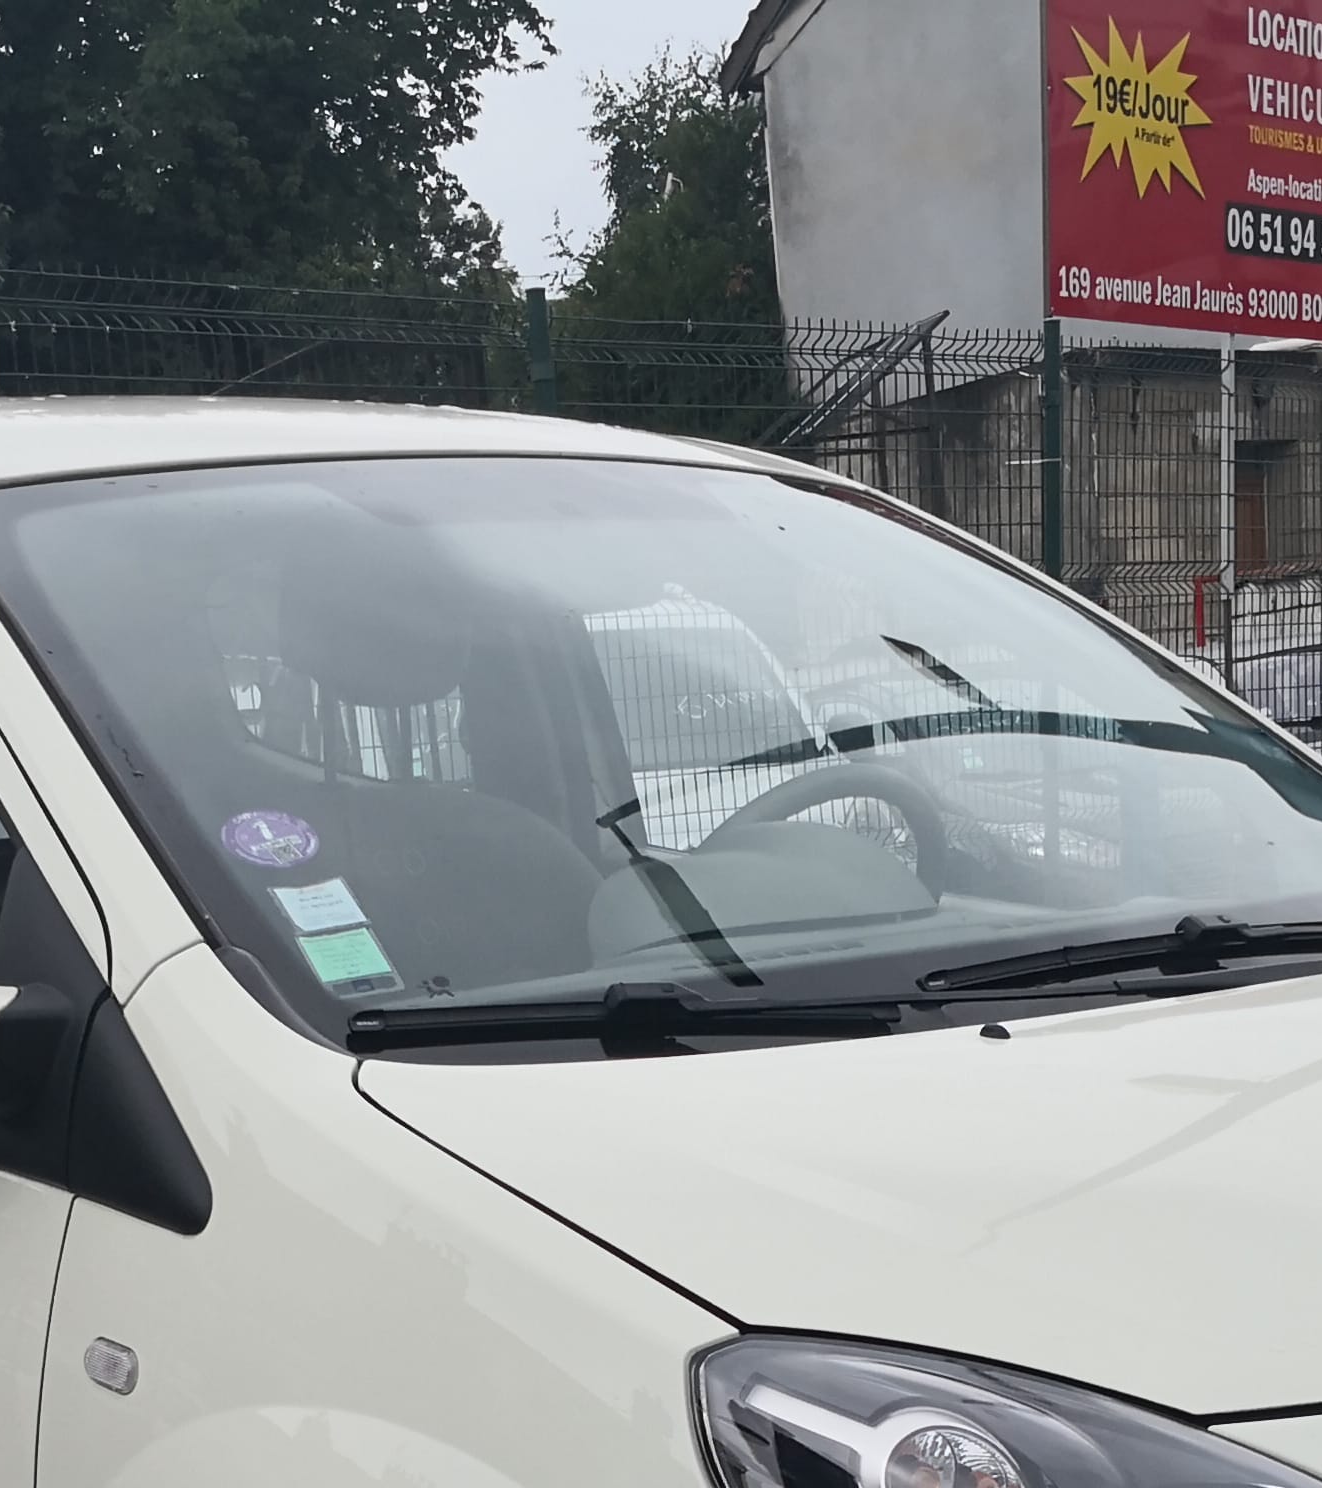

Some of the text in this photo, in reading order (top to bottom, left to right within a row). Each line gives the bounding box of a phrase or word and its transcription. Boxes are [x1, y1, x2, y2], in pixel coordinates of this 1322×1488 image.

[1092, 73, 1190, 126] 19€/Jour
[1247, 124, 1305, 152] TOURISMES
[1306, 134, 1315, 153] &
[1227, 207, 1254, 250] 06
[1259, 213, 1284, 254] 51
[1290, 217, 1316, 258] 94
[1058, 265, 1091, 299] 169
[1095, 274, 1152, 305] avenue
[1155, 275, 1191, 310] Jean
[1193, 280, 1244, 317] Jaurès
[1247, 287, 1298, 321] 93000
